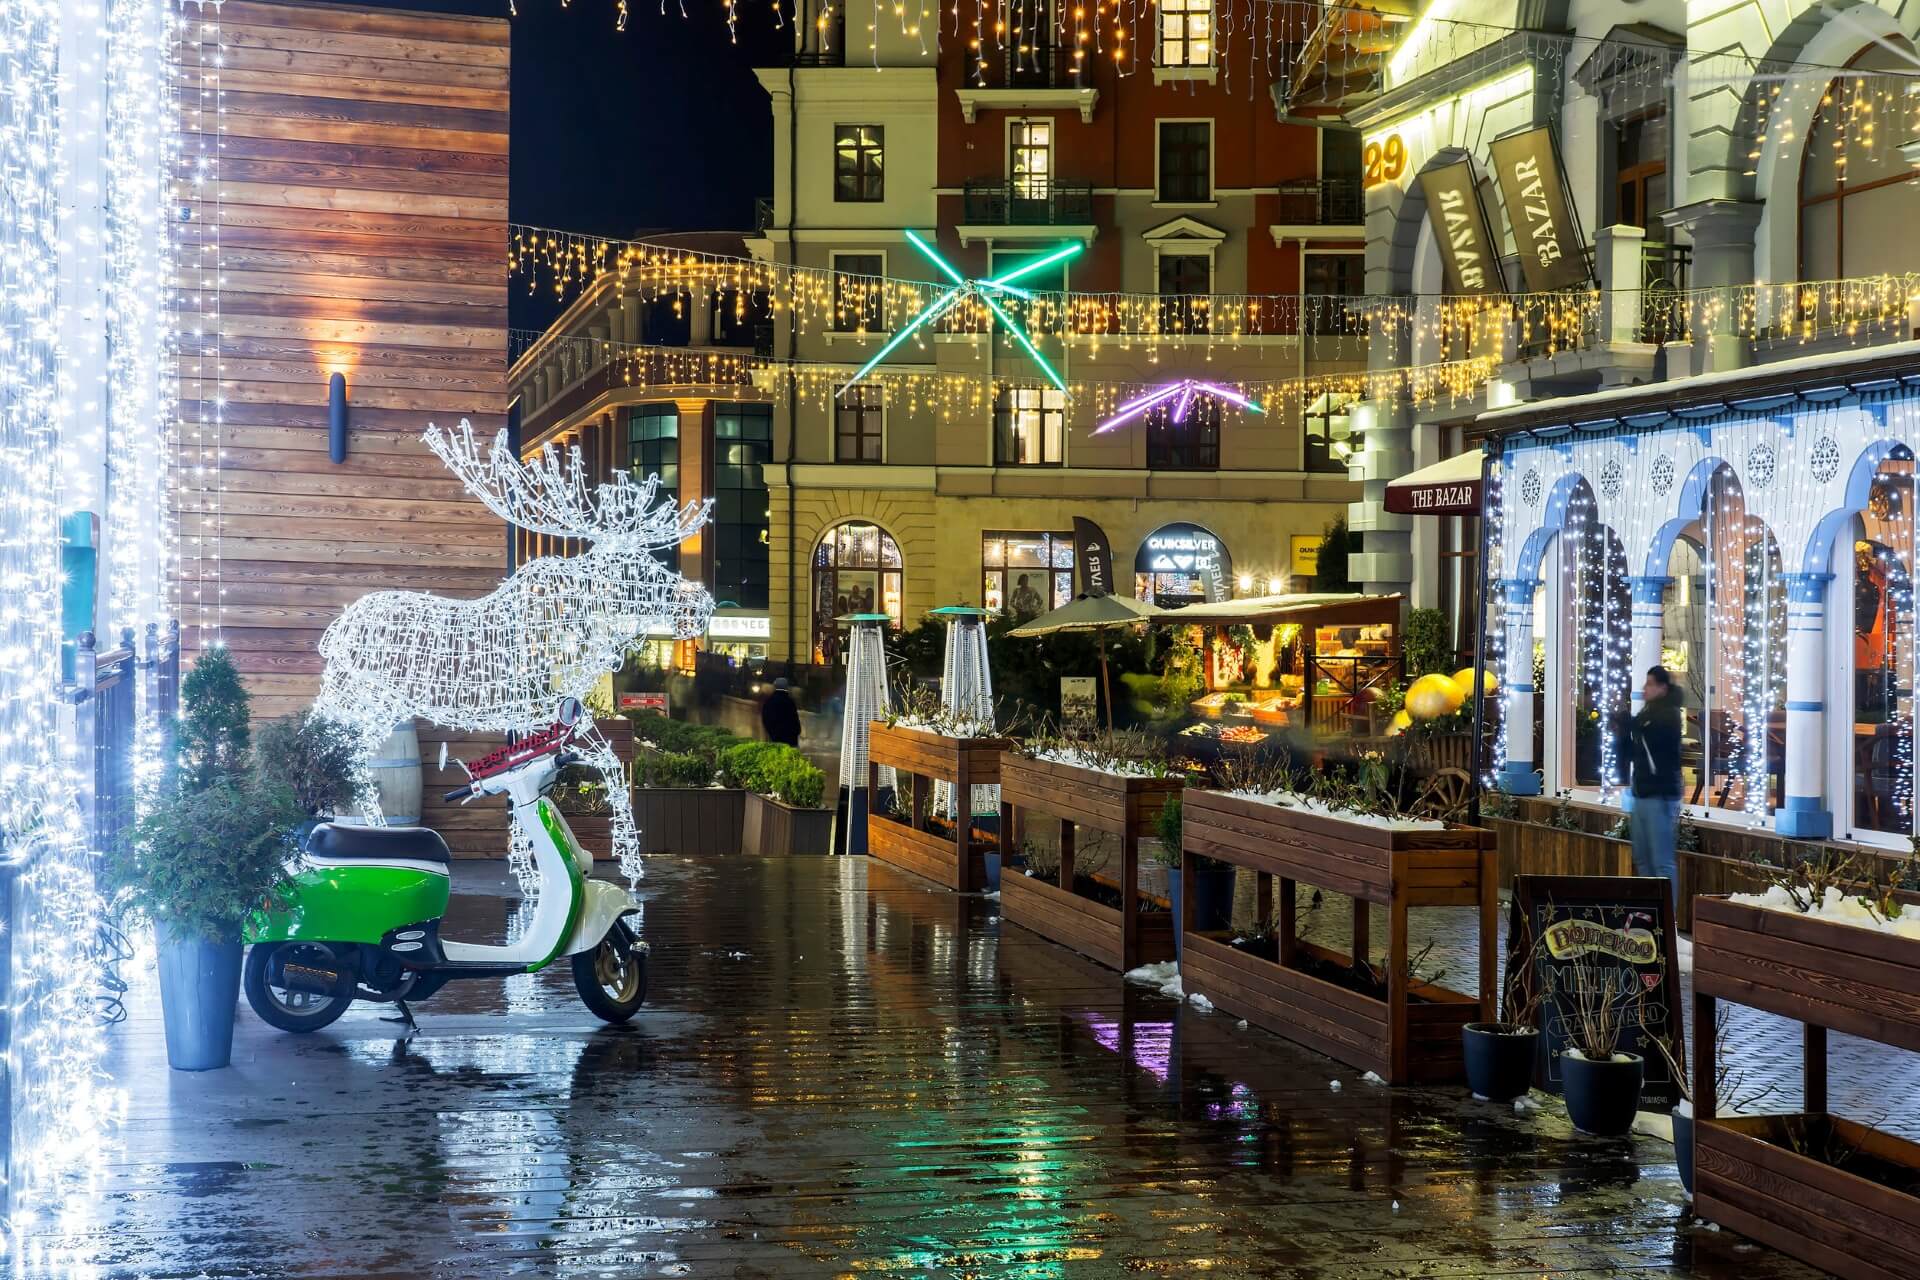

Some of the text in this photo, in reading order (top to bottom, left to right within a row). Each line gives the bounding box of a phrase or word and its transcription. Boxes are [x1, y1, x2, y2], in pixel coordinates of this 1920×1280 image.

[1363, 133, 1407, 190] 29
[1515, 155, 1562, 259] BAZAR
[1411, 486, 1472, 508] THE BAZAR
